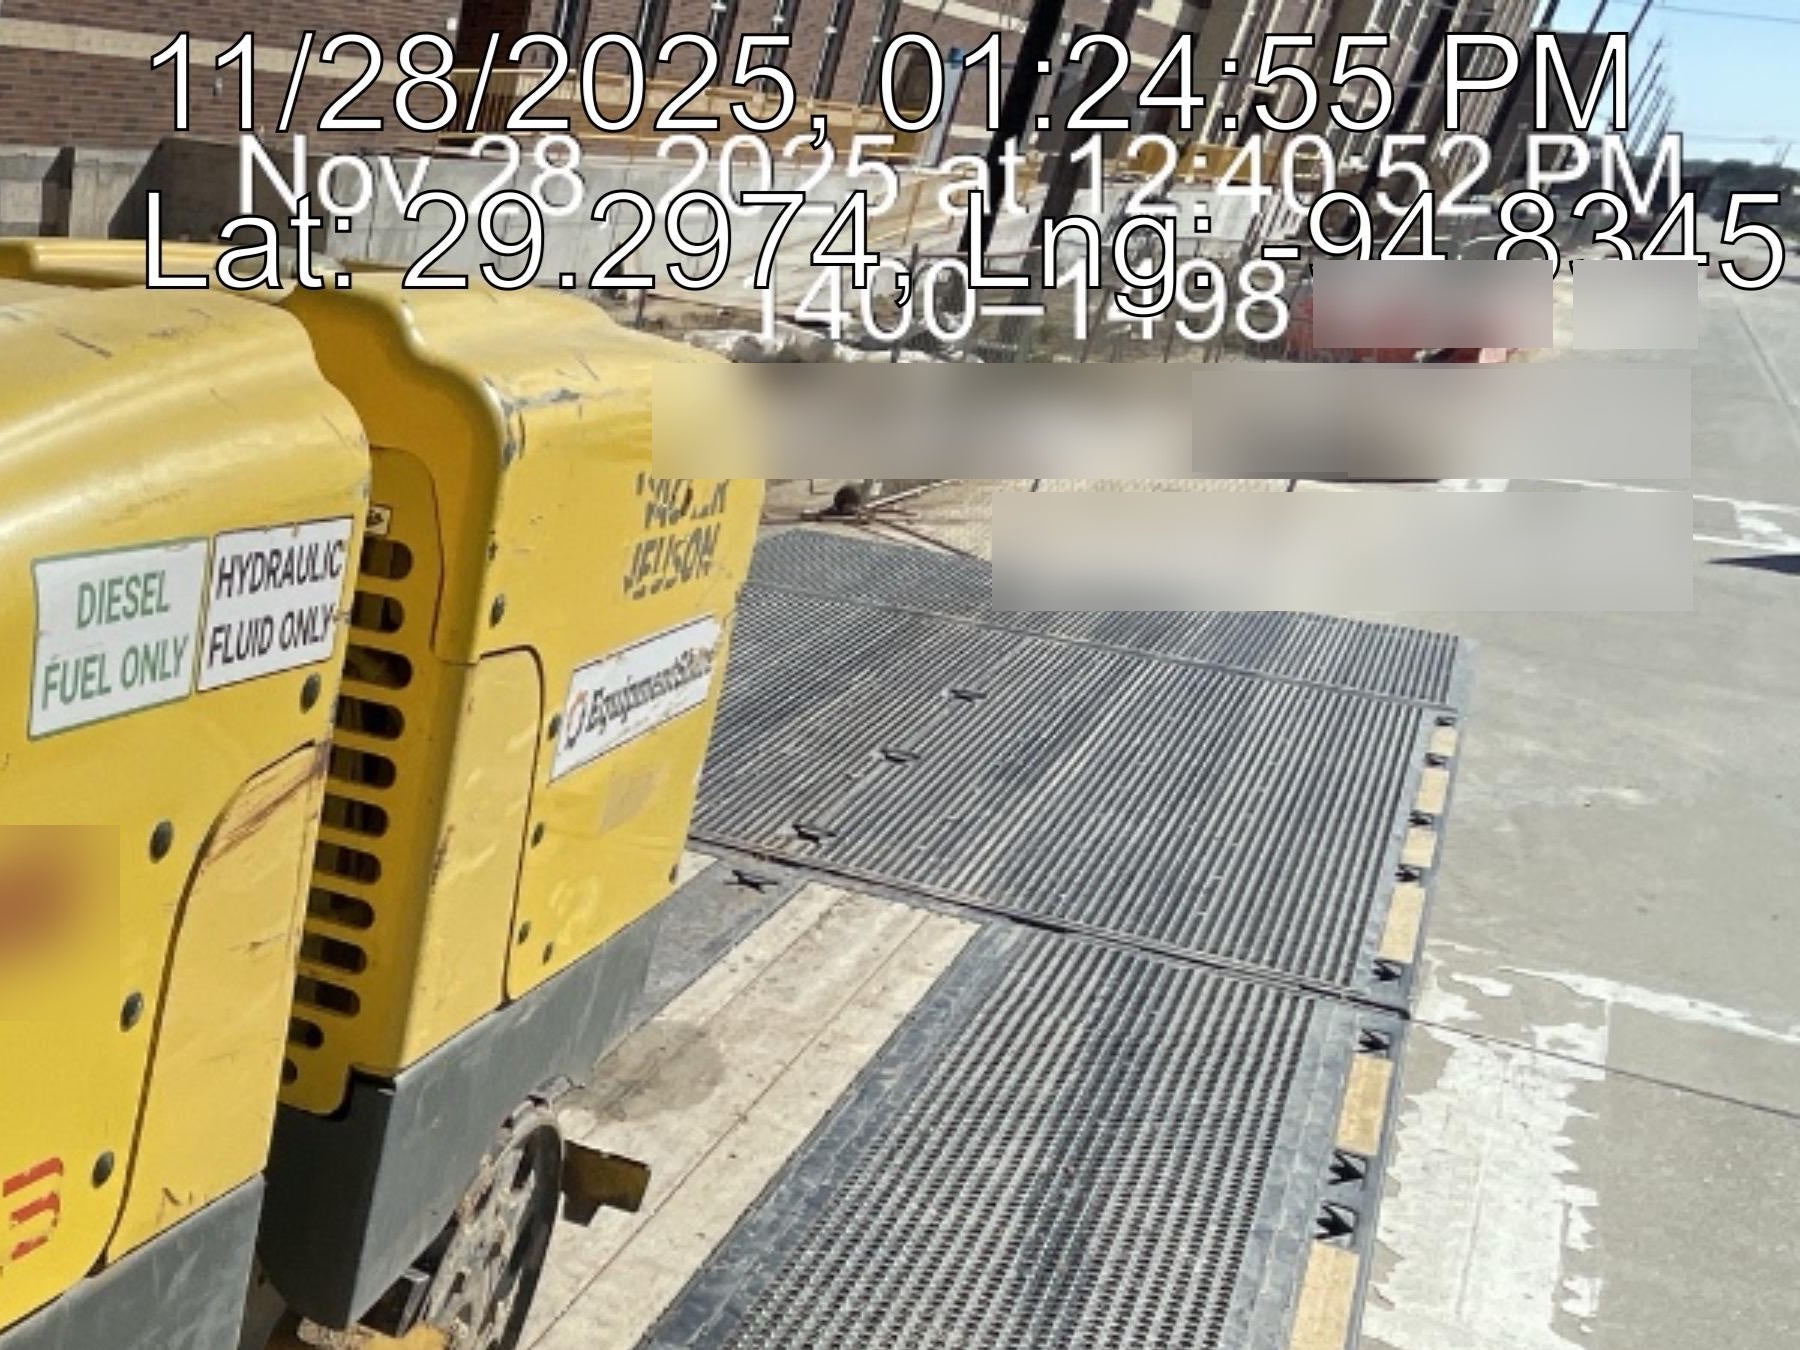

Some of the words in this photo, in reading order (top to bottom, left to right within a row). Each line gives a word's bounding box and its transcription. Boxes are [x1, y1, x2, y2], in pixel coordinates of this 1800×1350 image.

[76, 569, 171, 630] DIESEL
[215, 539, 346, 600] HYDRAULIC
[208, 614, 274, 668] FLUID
[279, 602, 336, 651] ONLY
[41, 652, 112, 711] FUEL
[120, 632, 190, 691] ONLY
